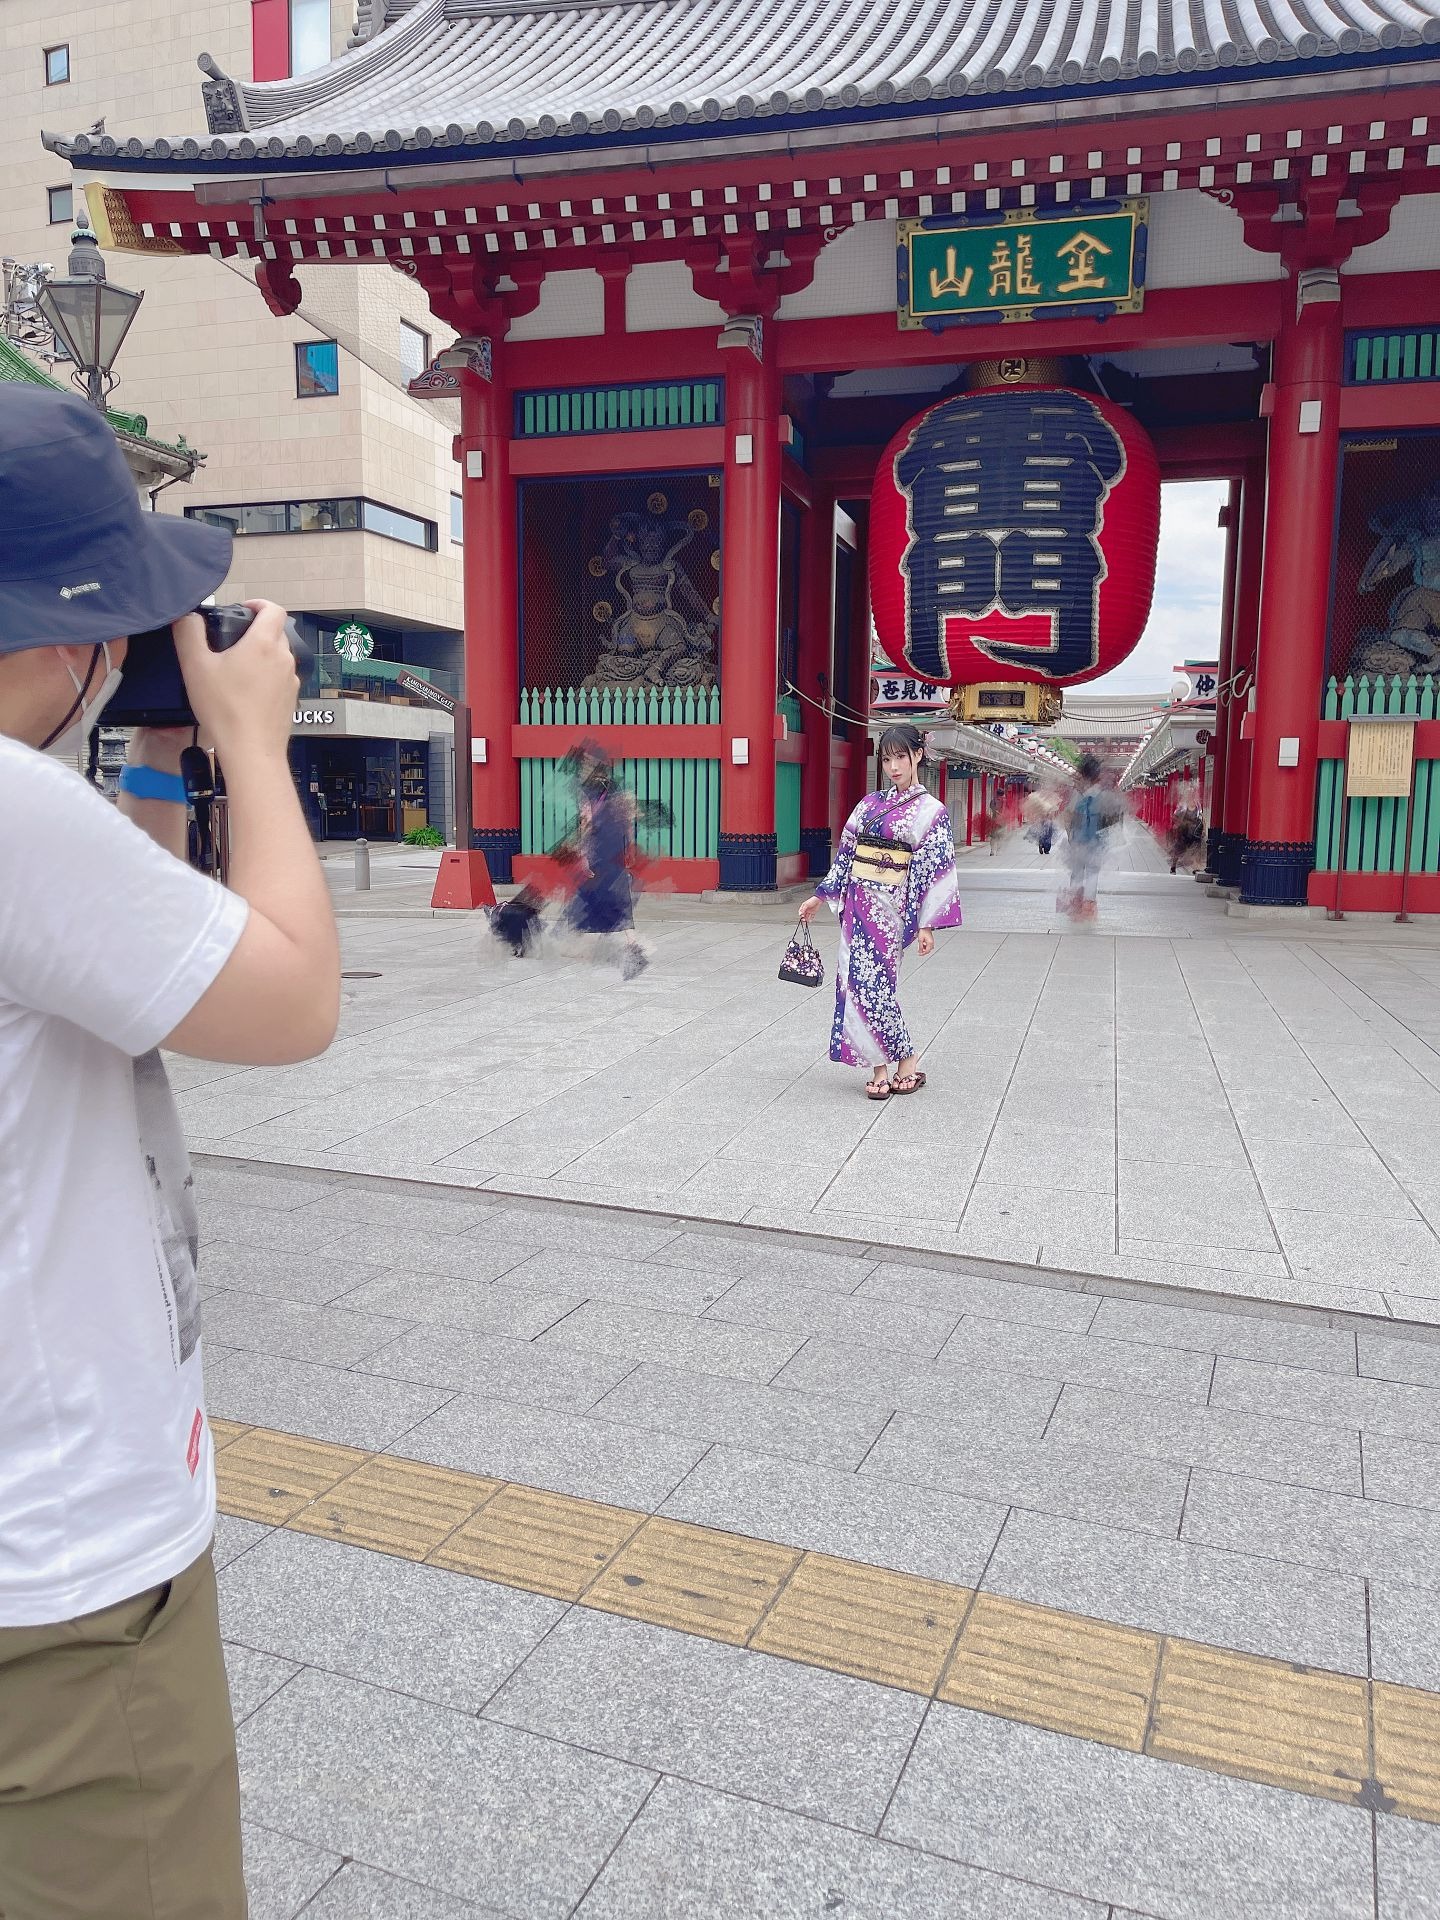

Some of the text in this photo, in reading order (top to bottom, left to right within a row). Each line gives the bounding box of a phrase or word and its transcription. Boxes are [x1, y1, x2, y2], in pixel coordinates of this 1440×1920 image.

[893, 389, 1127, 680] 雷門
[405, 676, 442, 700] KAMINARIMON
[440, 696, 455, 708] GATE
